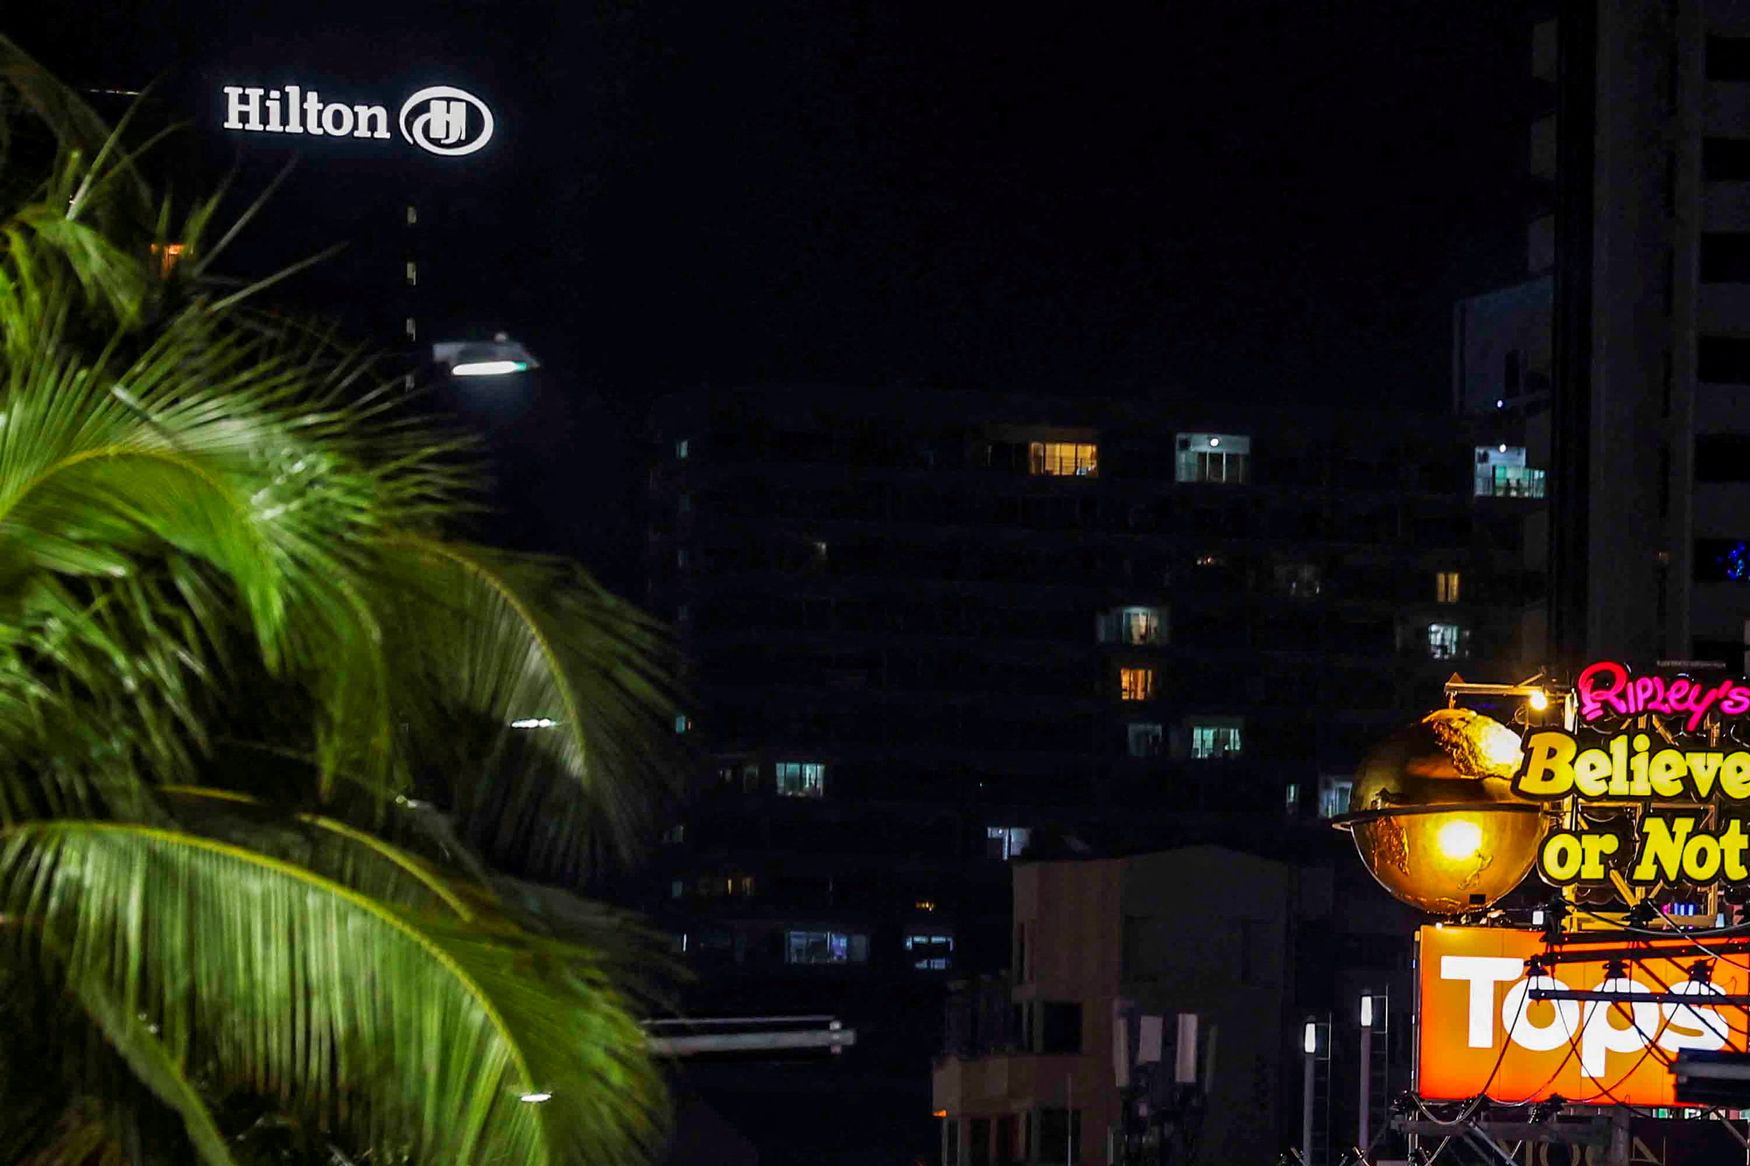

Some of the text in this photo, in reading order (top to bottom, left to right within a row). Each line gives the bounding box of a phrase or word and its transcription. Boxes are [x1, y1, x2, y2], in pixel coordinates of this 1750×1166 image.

[223, 85, 391, 139] Hilton
[1542, 834, 1619, 879] or
[1441, 955, 1729, 1078] Tops
